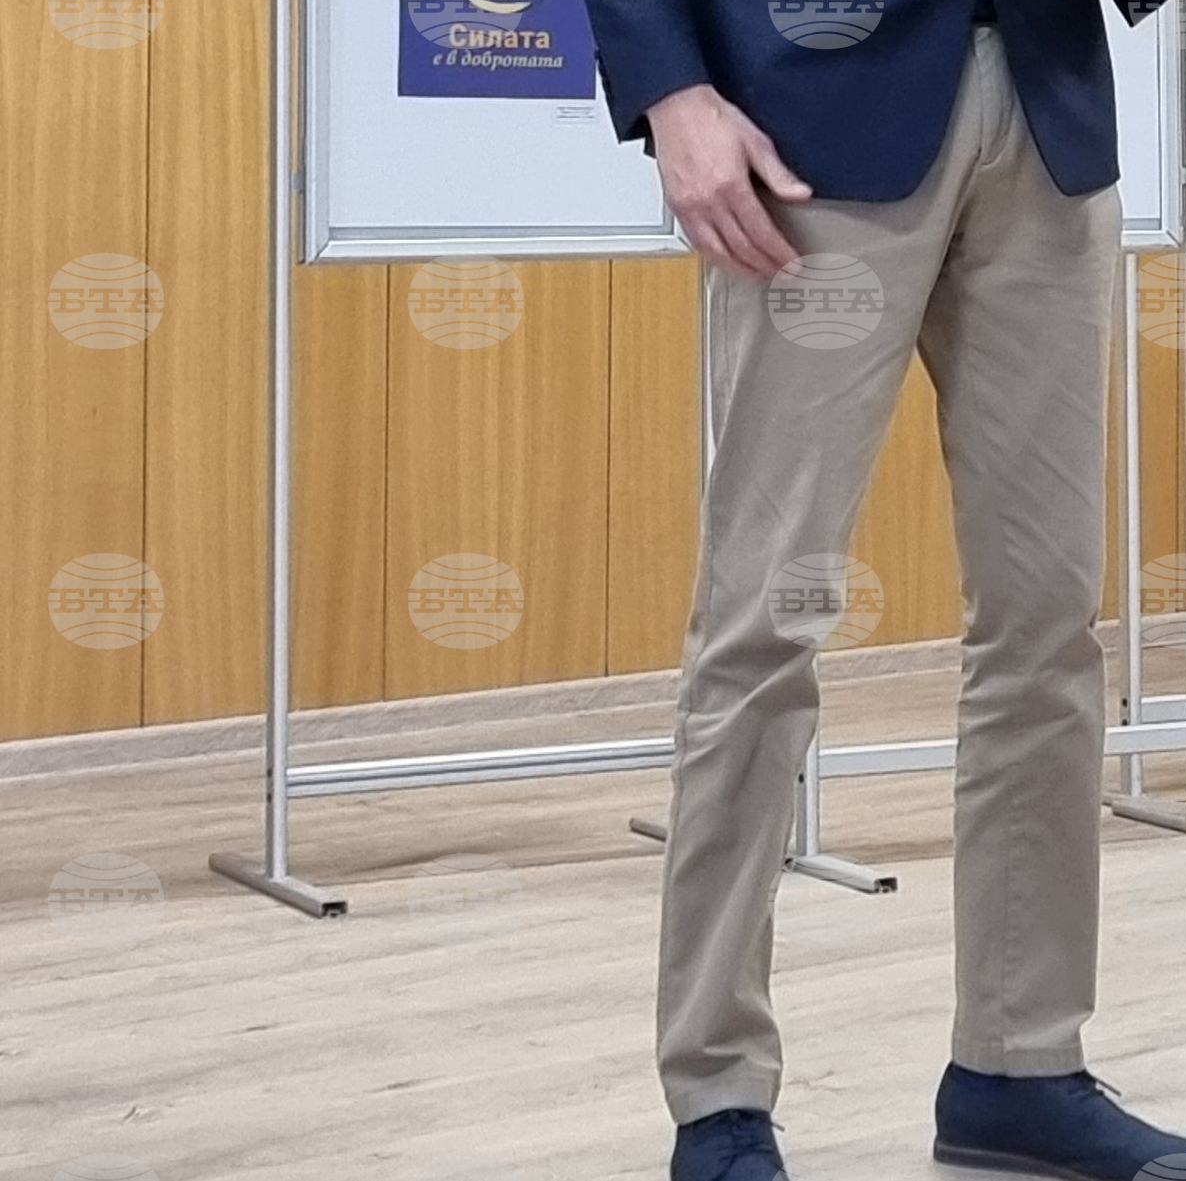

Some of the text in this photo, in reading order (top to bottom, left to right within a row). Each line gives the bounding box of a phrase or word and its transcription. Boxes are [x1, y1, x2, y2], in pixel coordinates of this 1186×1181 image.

[450, 23, 551, 49] Силата
[433, 51, 563, 71] е в добротата
